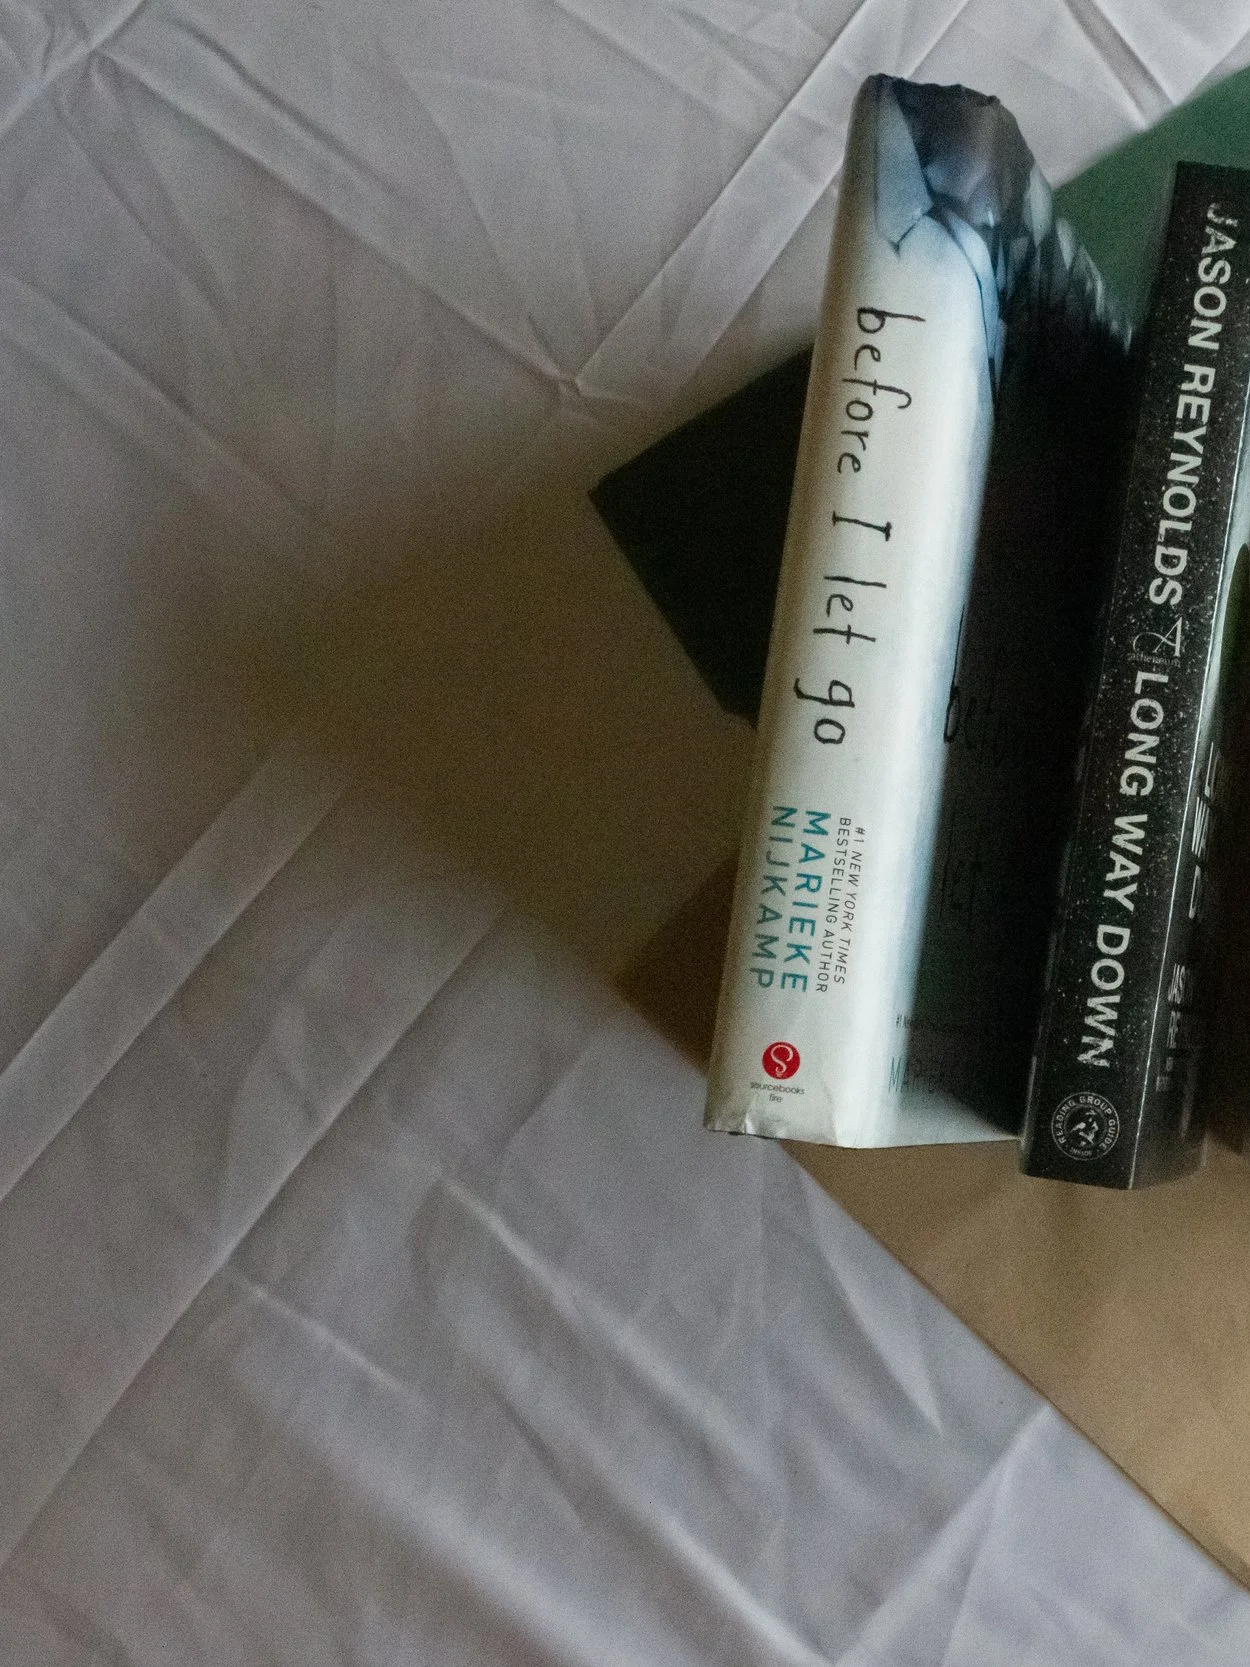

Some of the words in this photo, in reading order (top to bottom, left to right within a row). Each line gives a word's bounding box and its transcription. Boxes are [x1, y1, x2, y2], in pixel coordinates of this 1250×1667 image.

[1188, 202, 1239, 351] JASON
[837, 307, 926, 474] before
[1148, 363, 1216, 606] REYNOLDS
[832, 511, 892, 542] I
[813, 575, 887, 645] let
[794, 678, 855, 745] go
[1119, 670, 1170, 797] LONG
[847, 850, 863, 887] NEW
[852, 826, 866, 843] #1
[1103, 813, 1149, 912] WAY
[749, 805, 798, 989] NIJKAMP
[780, 809, 832, 993] MARIEKE
[825, 817, 852, 924] BESTSELLING
[840, 891, 857, 932] YORK
[815, 929, 835, 993] AUTHOR
[833, 938, 851, 984] TIMES
[1075, 924, 1132, 1069] DOWN
[750, 1081, 805, 1095] sourcebooks
[1055, 1099, 1077, 1145] READING
[1079, 1095, 1113, 1116] GROUP
[1098, 1118, 1116, 1151] GUIDE
